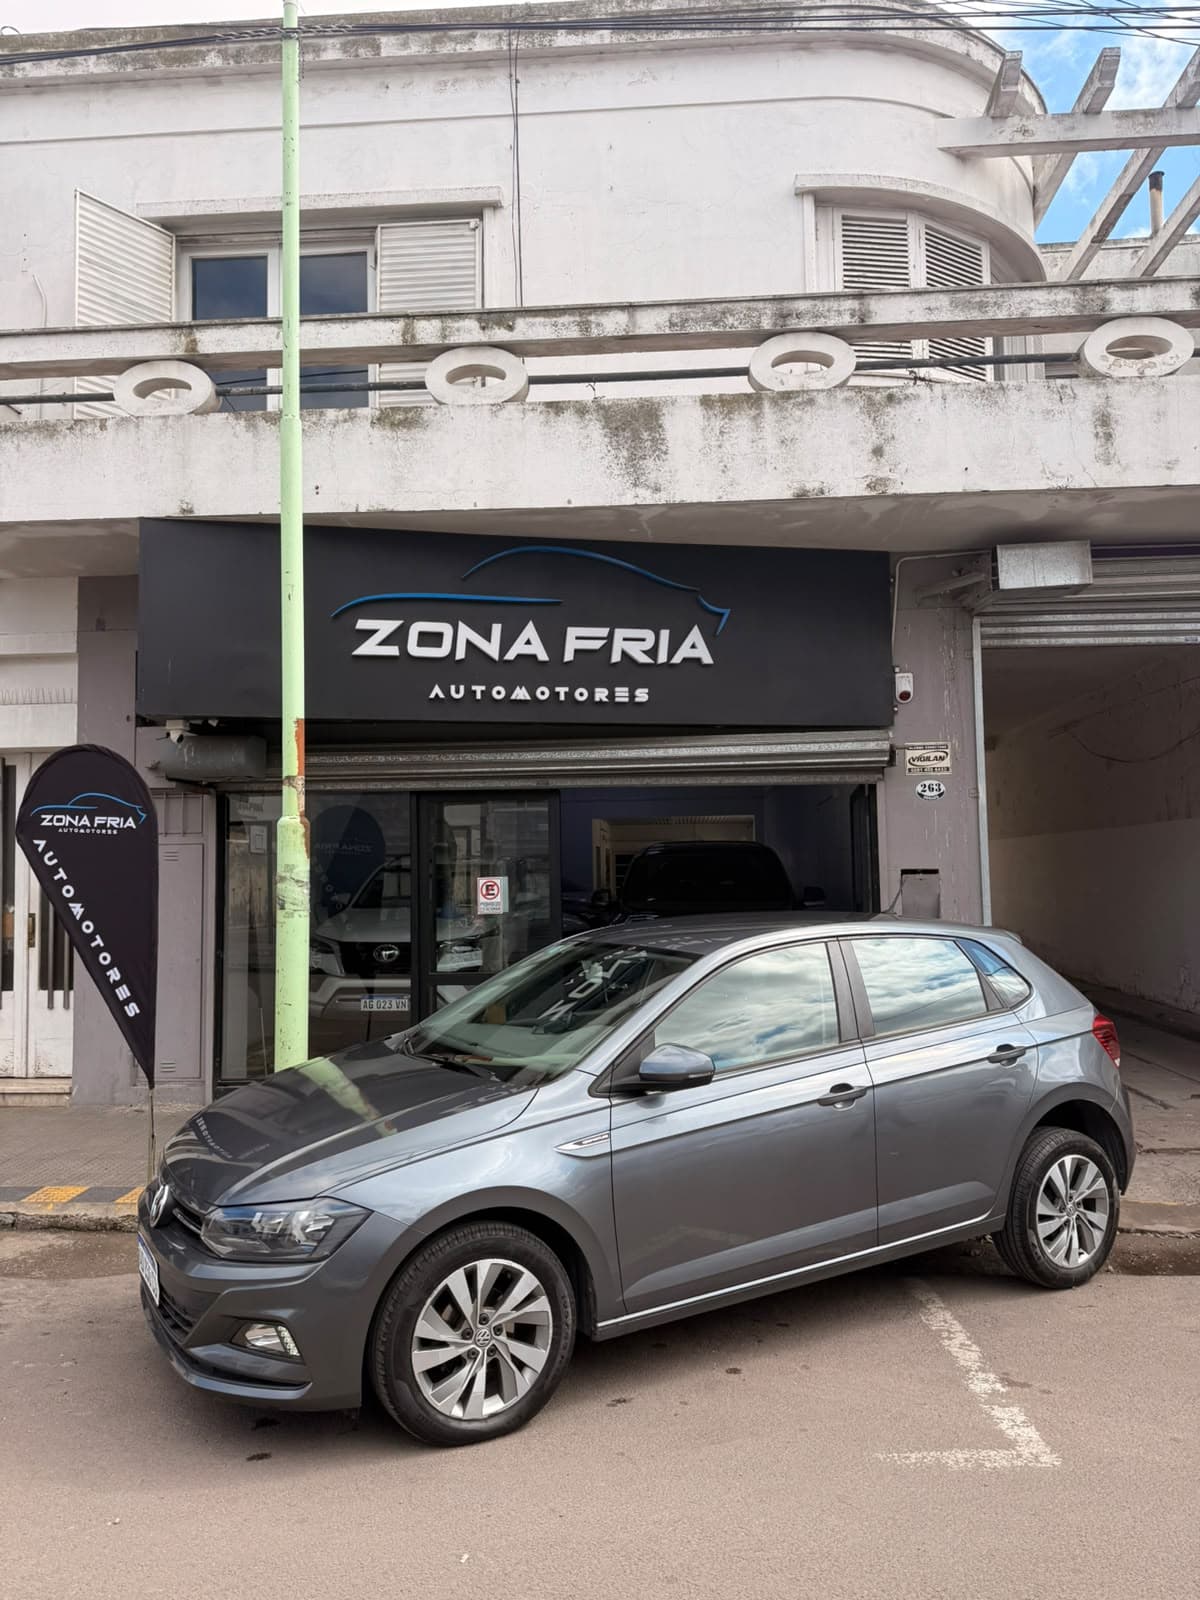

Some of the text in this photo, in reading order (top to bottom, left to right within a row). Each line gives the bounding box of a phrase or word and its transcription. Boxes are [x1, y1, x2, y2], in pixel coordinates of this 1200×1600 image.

[352, 619, 715, 665] ZONA FRIA
[428, 683, 650, 703] AUTOMOTORES
[920, 783, 942, 792] 263
[40, 814, 137, 829] ZONA FRIA
[32, 839, 141, 1018] AUTOMOTORES
[362, 1000, 374, 1009] AG
[376, 1000, 393, 1009] 023
